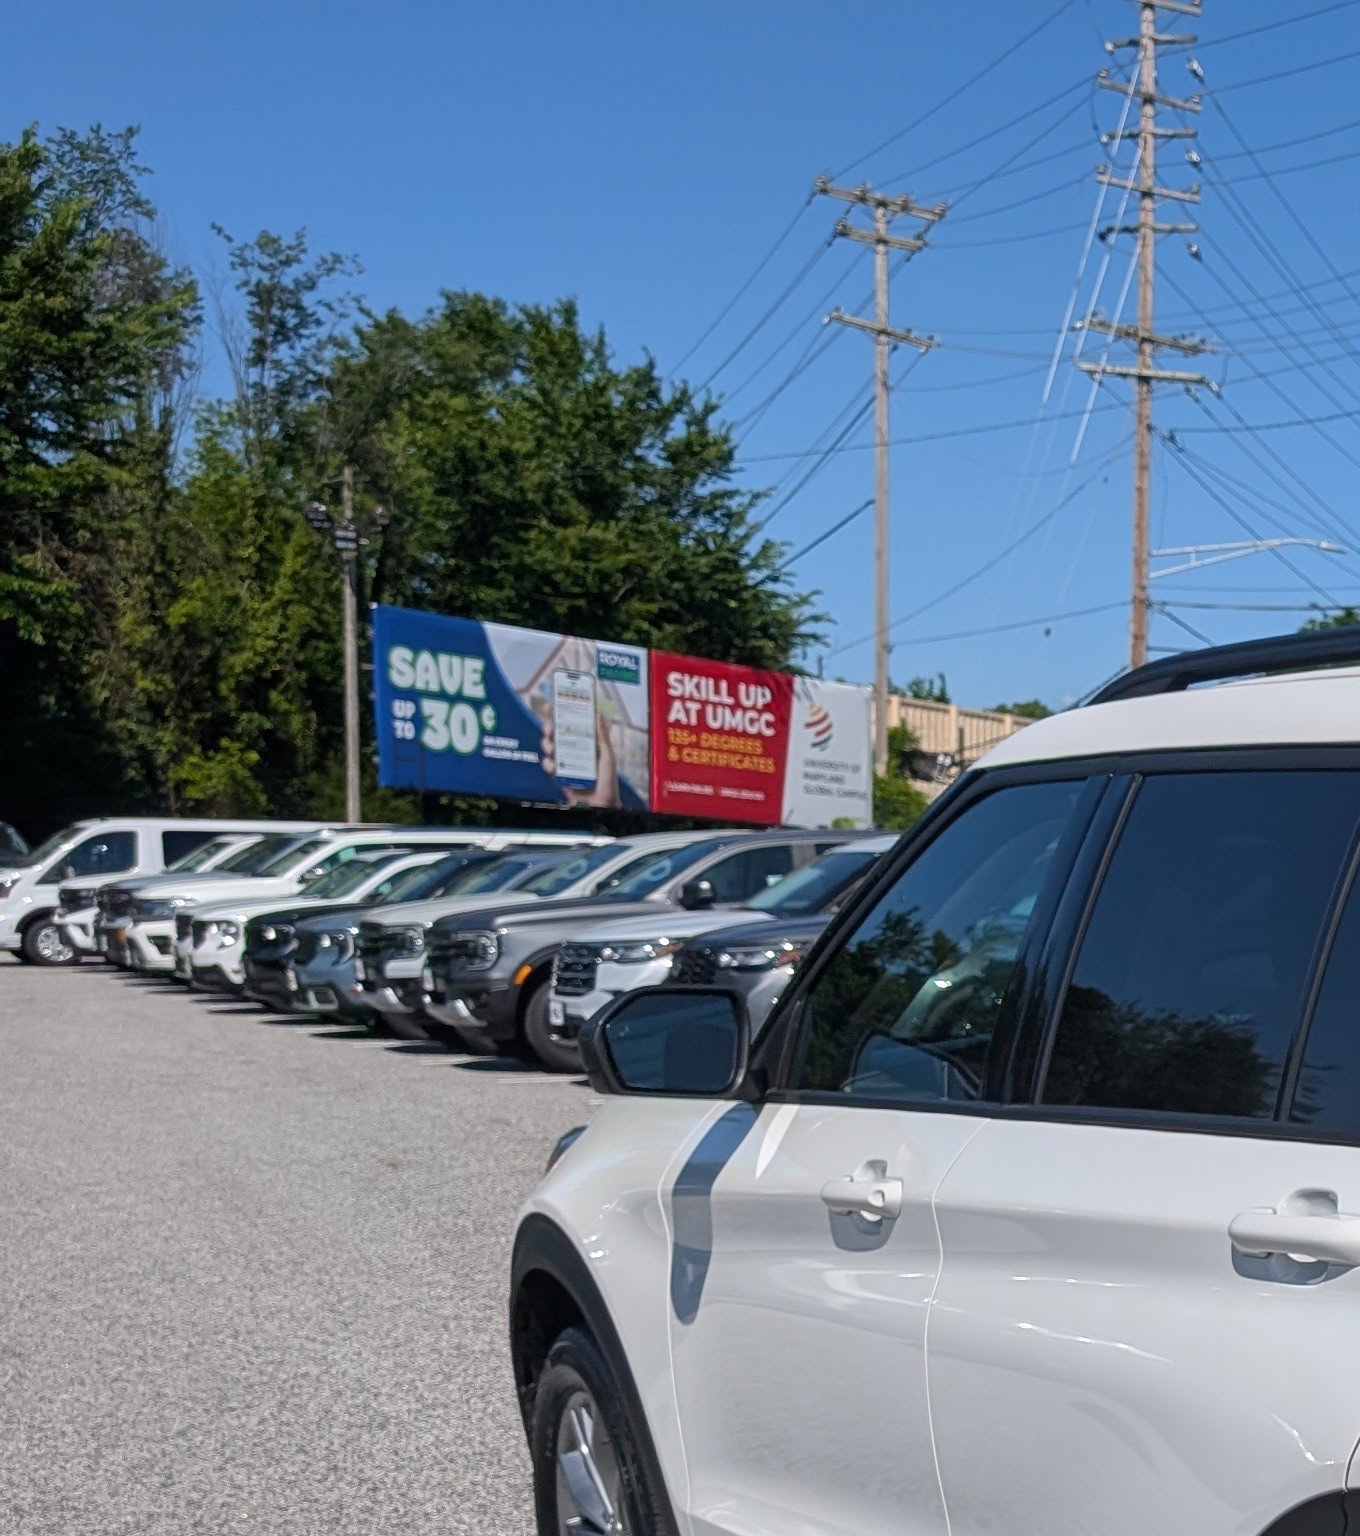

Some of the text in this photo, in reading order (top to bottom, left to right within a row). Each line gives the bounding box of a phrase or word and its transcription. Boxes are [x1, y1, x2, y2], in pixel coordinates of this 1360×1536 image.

[389, 645, 486, 699] SAVE
[667, 671, 735, 705] SKILL
[738, 682, 772, 709] UP
[392, 698, 416, 720] UP
[667, 699, 776, 737] AT UMGC
[392, 719, 416, 740] TO
[700, 732, 763, 754] DEGREES
[667, 744, 776, 774] & CERTIFICATES
